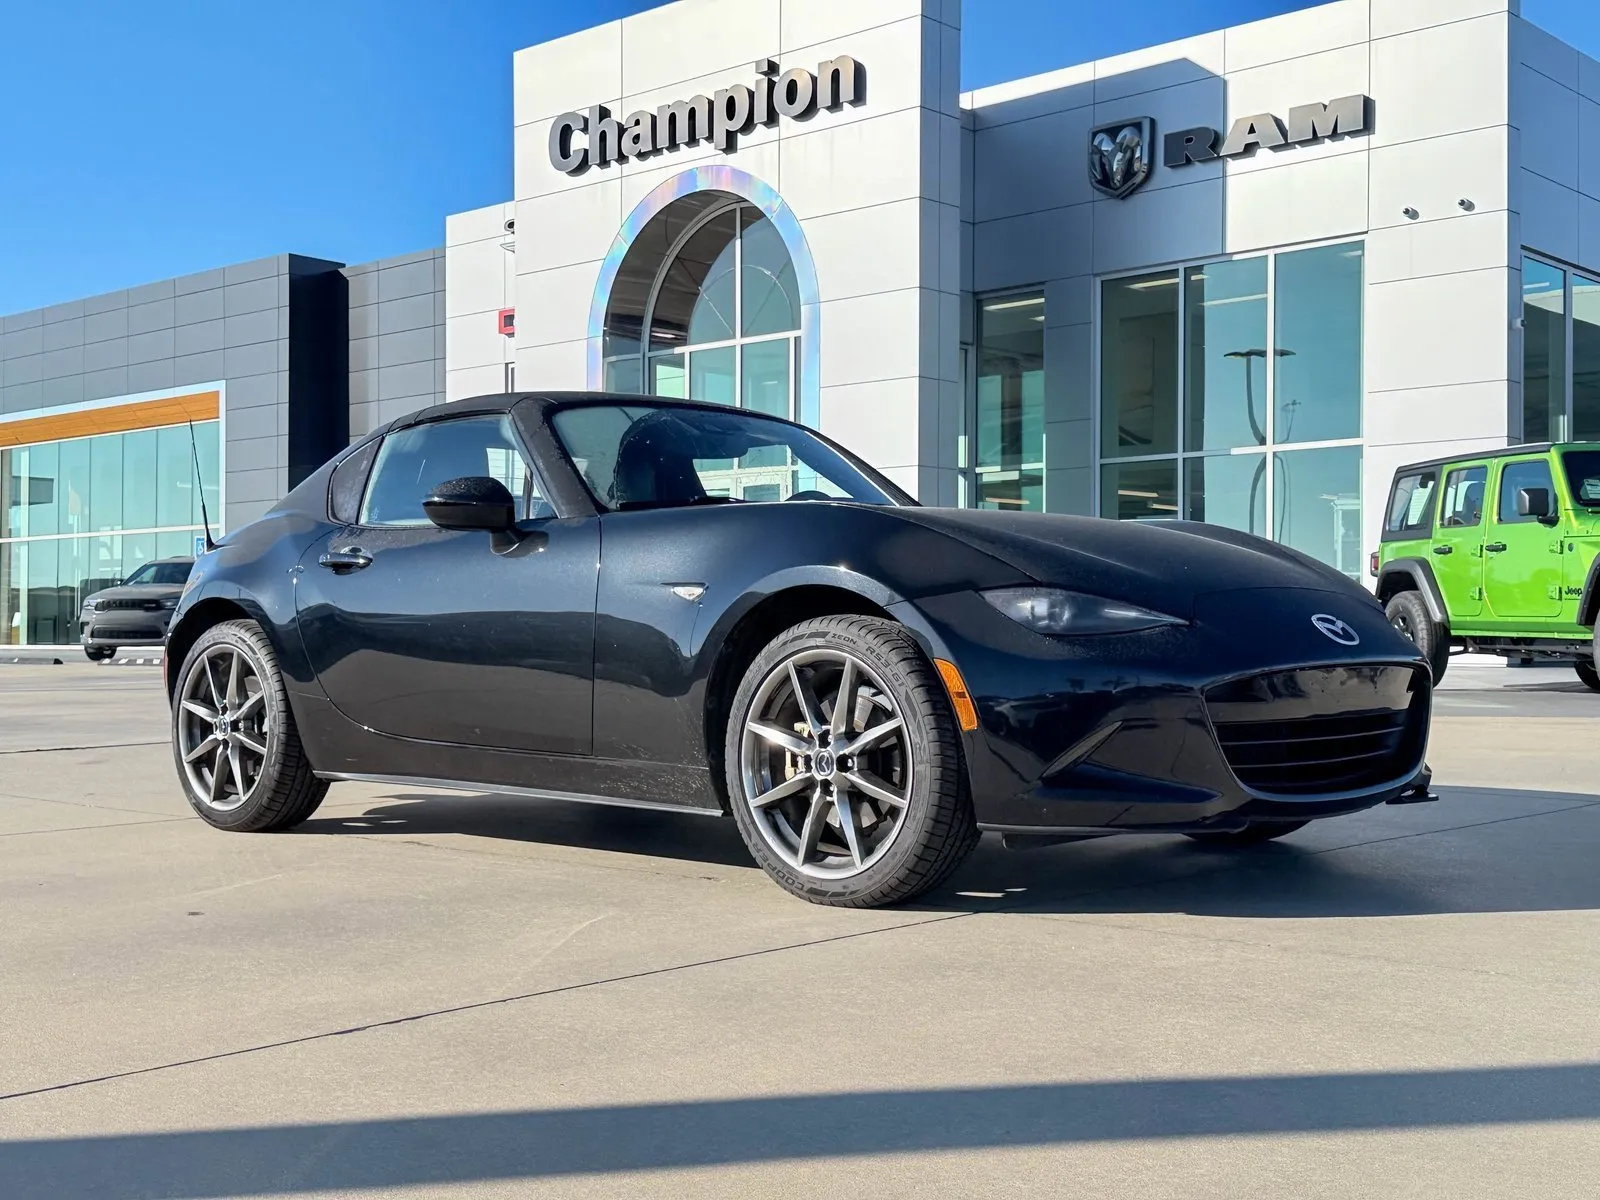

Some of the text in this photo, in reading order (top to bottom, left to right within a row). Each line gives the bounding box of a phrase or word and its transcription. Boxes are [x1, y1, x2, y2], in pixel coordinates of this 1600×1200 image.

[549, 54, 866, 176] Champion
[1163, 94, 1375, 167] RAM
[1564, 586, 1583, 597] Jeep
[831, 632, 857, 645] ZEON
[752, 842, 805, 891] COOPER
